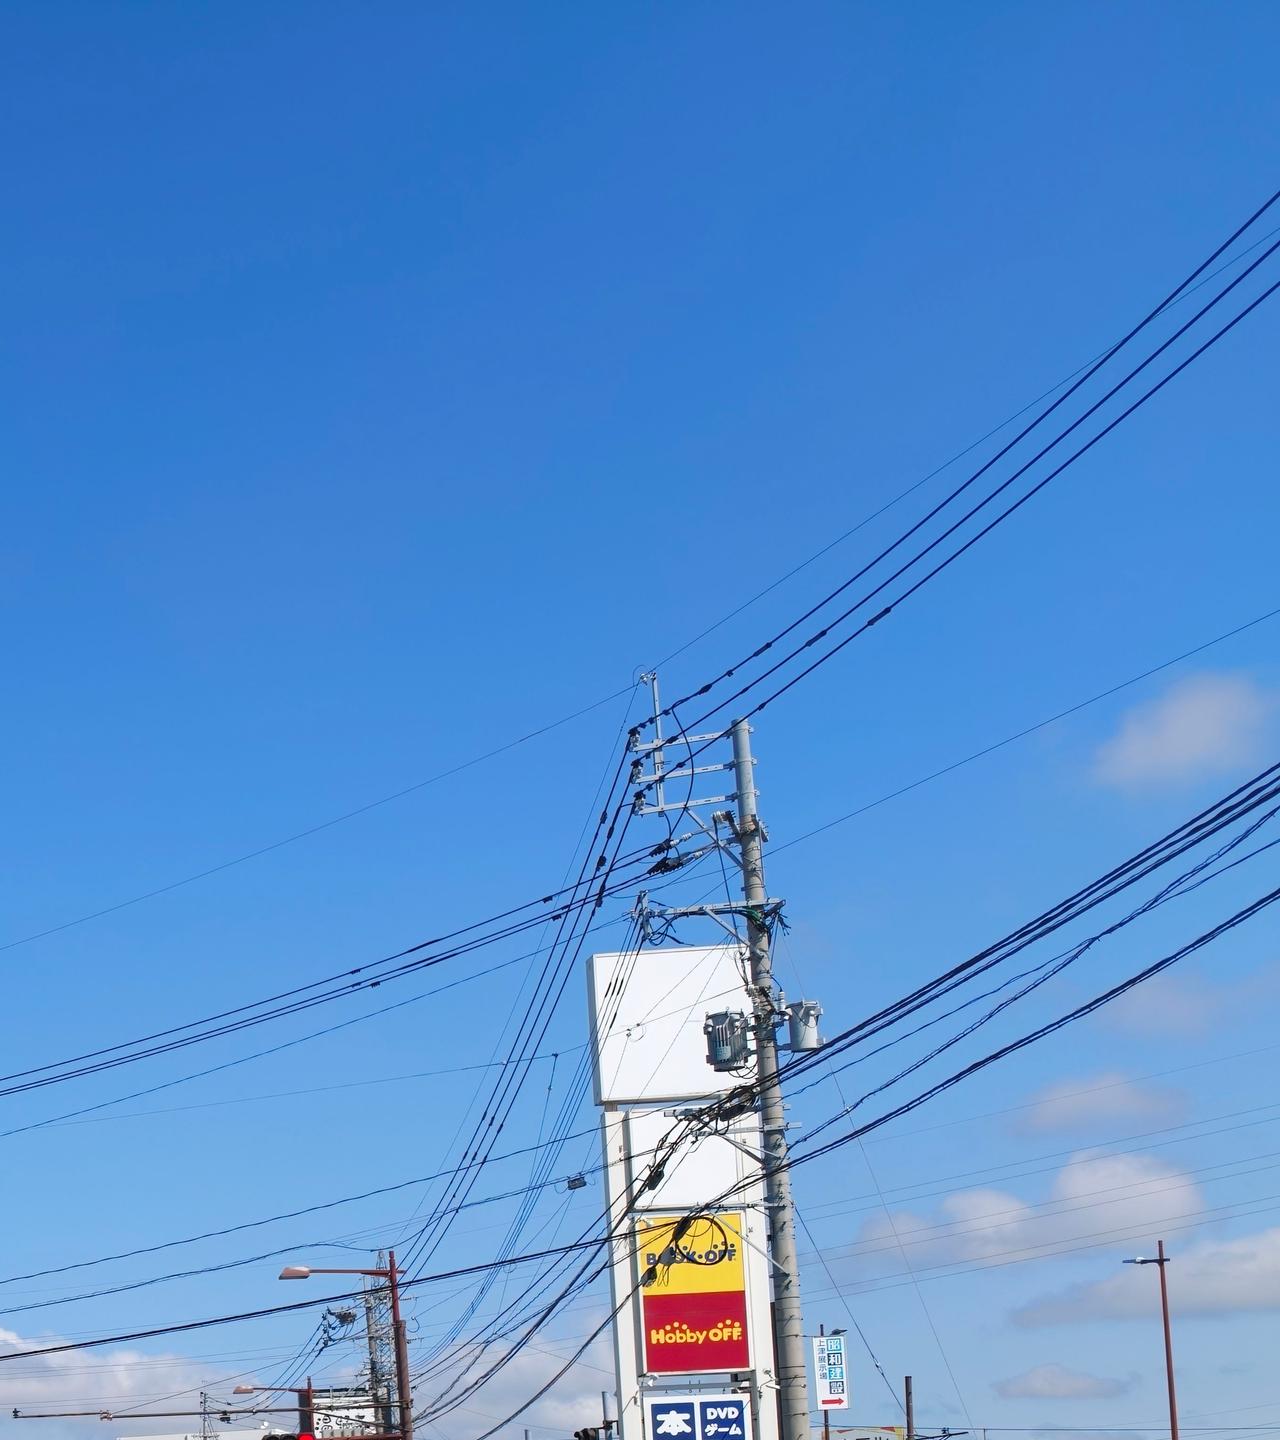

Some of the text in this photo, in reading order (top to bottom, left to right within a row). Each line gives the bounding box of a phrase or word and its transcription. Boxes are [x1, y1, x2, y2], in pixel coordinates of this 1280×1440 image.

[650, 1325, 742, 1345] Hobby OFF
[706, 1407, 739, 1420] DVD
[656, 1410, 692, 1435] 本
[704, 1423, 742, 1437] ゲーム
